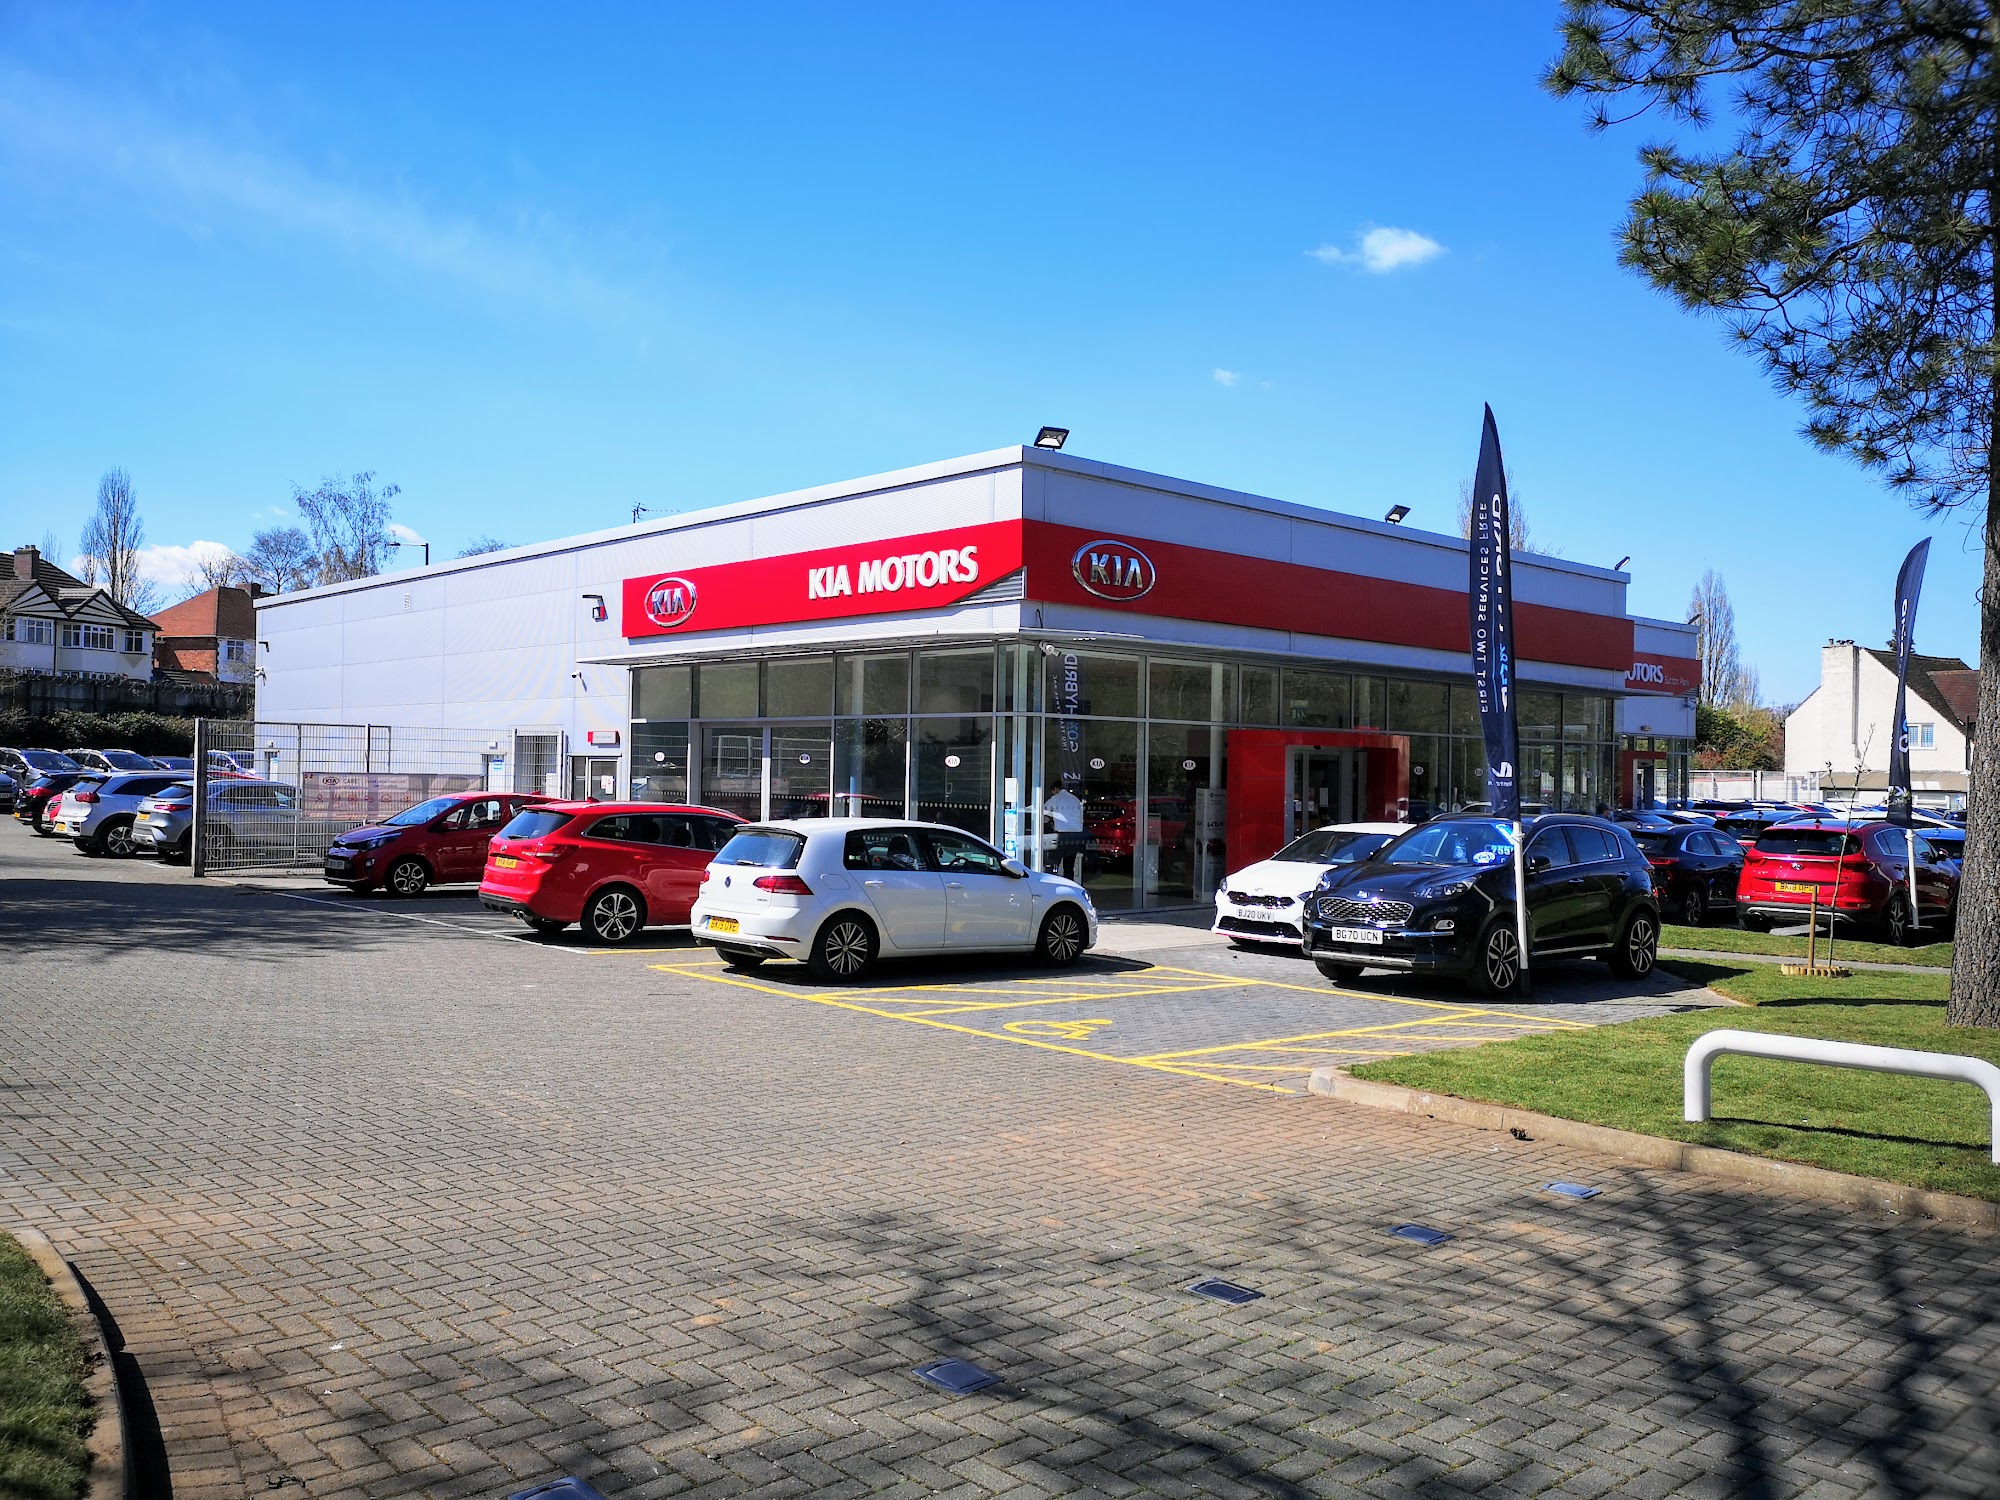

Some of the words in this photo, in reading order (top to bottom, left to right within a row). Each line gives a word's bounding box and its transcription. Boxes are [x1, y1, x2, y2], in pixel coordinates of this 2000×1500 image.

[808, 565, 853, 601] KIA
[858, 545, 979, 595] MOTORS
[1088, 551, 1144, 589] KIA
[651, 588, 687, 616] KIA
[1625, 663, 1664, 684] OTORS
[1238, 908, 1256, 919] BJ20
[1257, 911, 1272, 920] UKV
[1336, 929, 1359, 940] BG70
[1360, 931, 1379, 942] UCN
